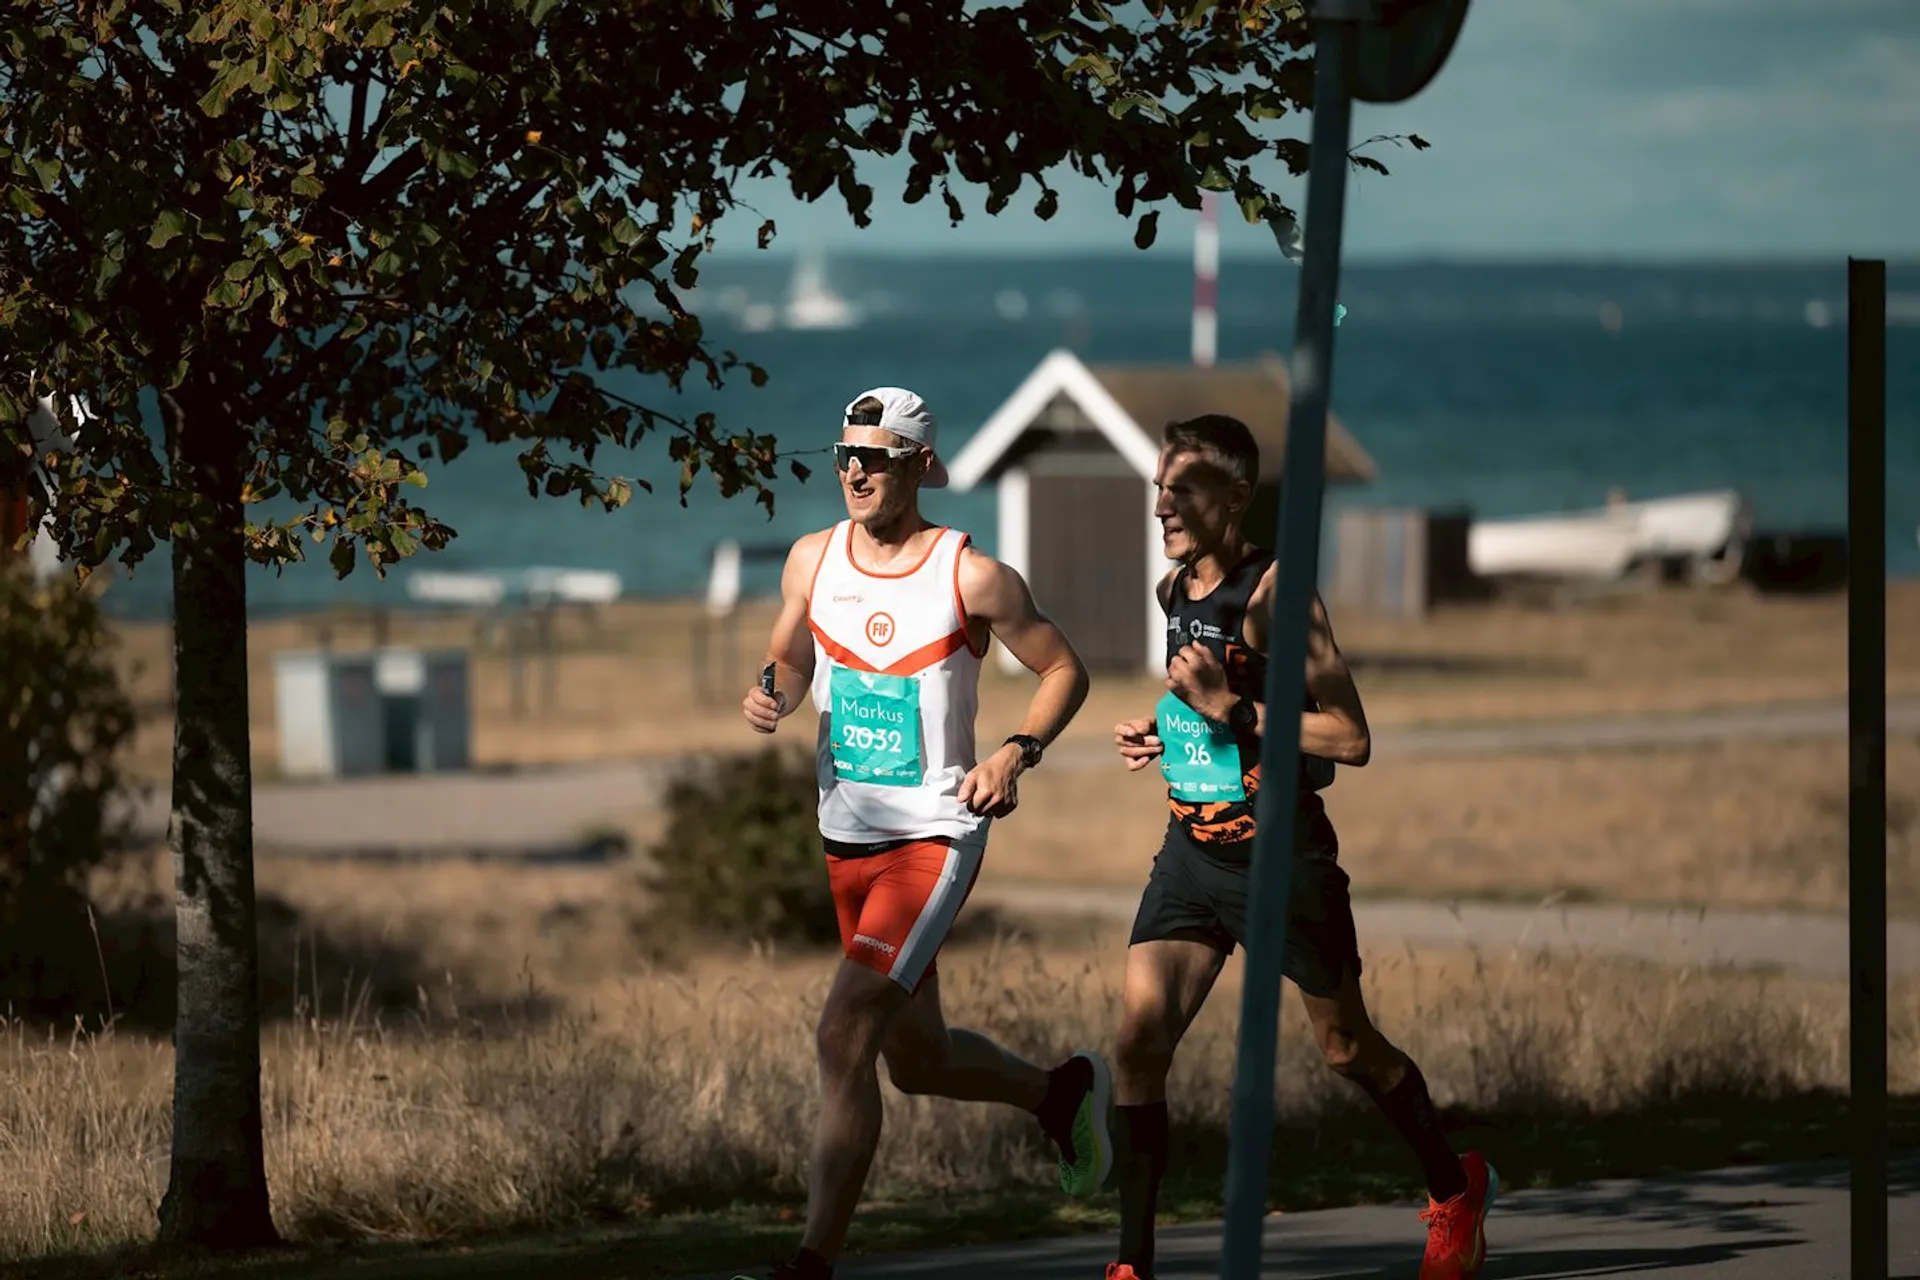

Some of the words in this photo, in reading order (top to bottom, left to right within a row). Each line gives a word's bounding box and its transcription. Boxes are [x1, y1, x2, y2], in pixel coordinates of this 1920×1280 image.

[872, 622, 888, 637] FIF
[841, 696, 904, 724] Markus
[1165, 712, 1225, 738] Magnus
[842, 724, 902, 753] 2032
[1184, 741, 1212, 767] 26
